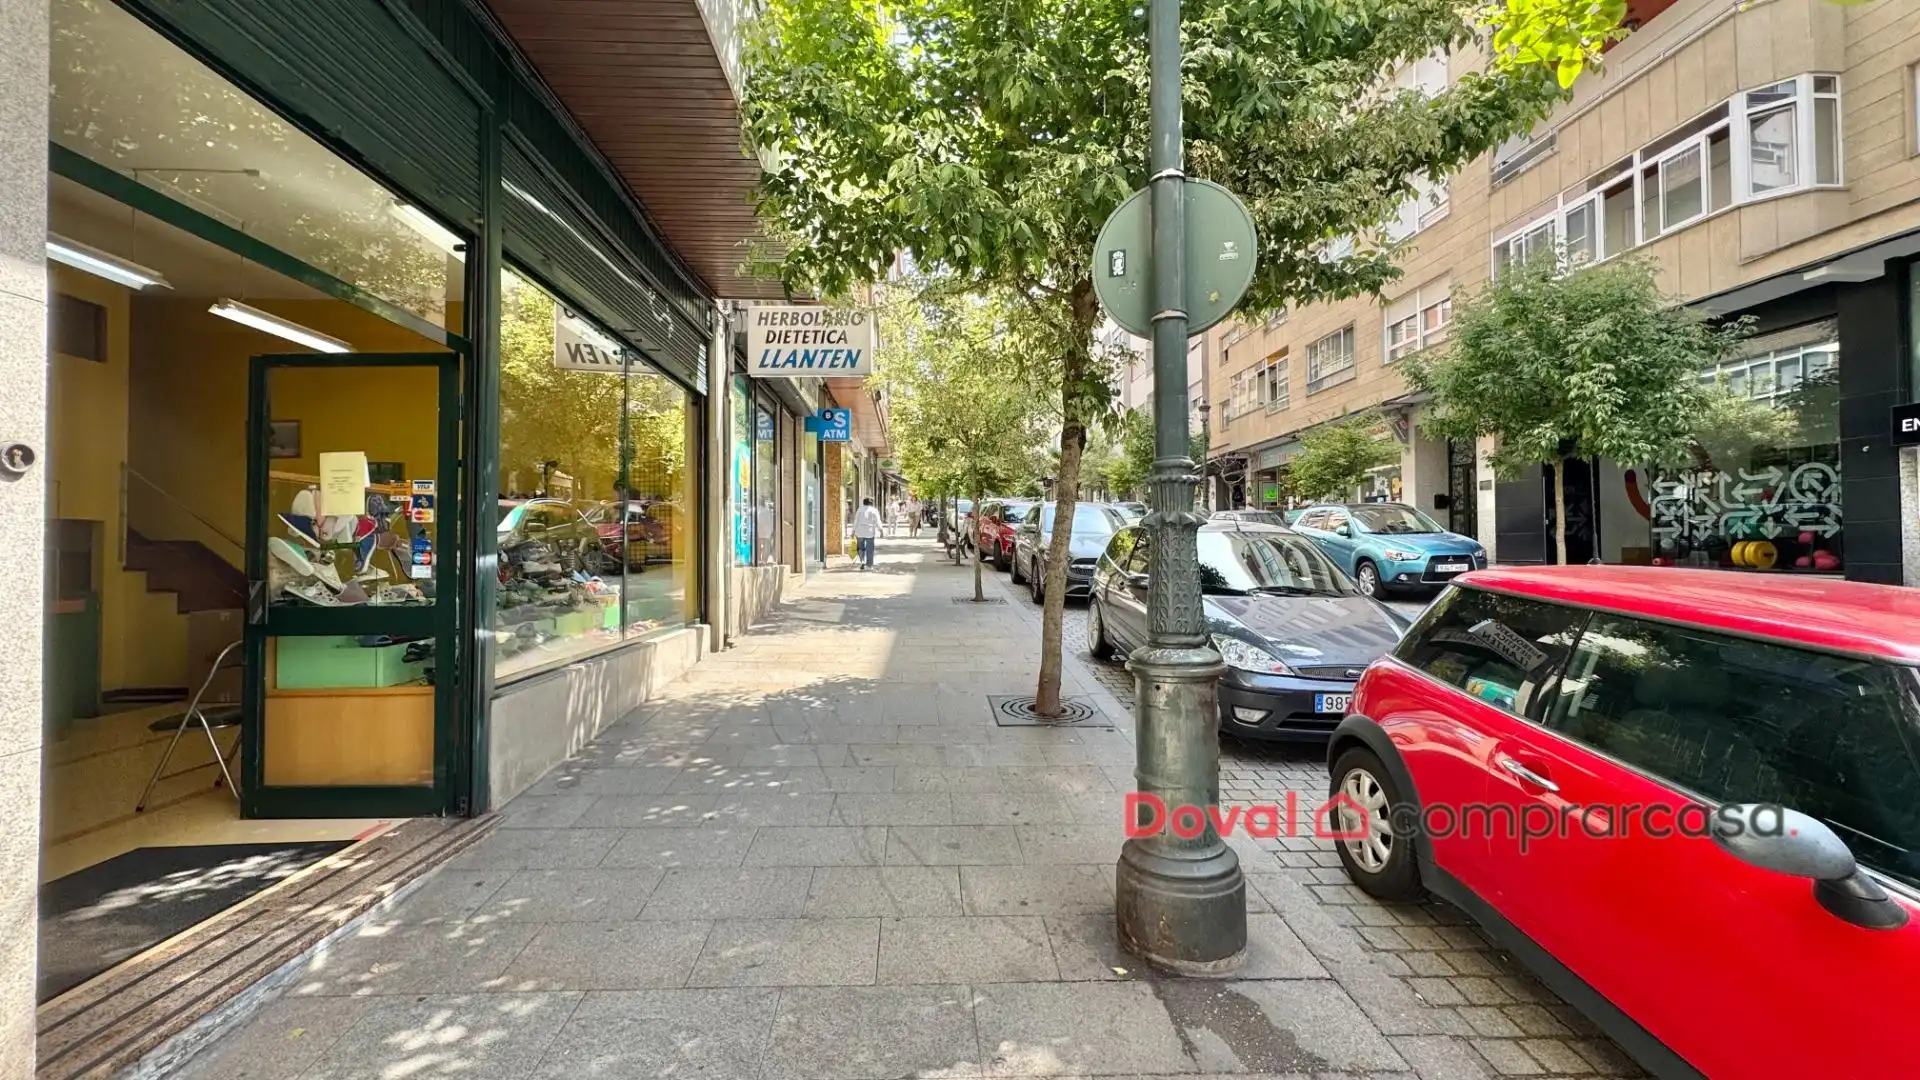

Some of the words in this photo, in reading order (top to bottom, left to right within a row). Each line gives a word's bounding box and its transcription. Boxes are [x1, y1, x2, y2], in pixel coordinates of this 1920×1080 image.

[765, 329, 849, 345] DIETETICA
[758, 348, 863, 369] LLANTEN
[823, 429, 847, 439] ATM
